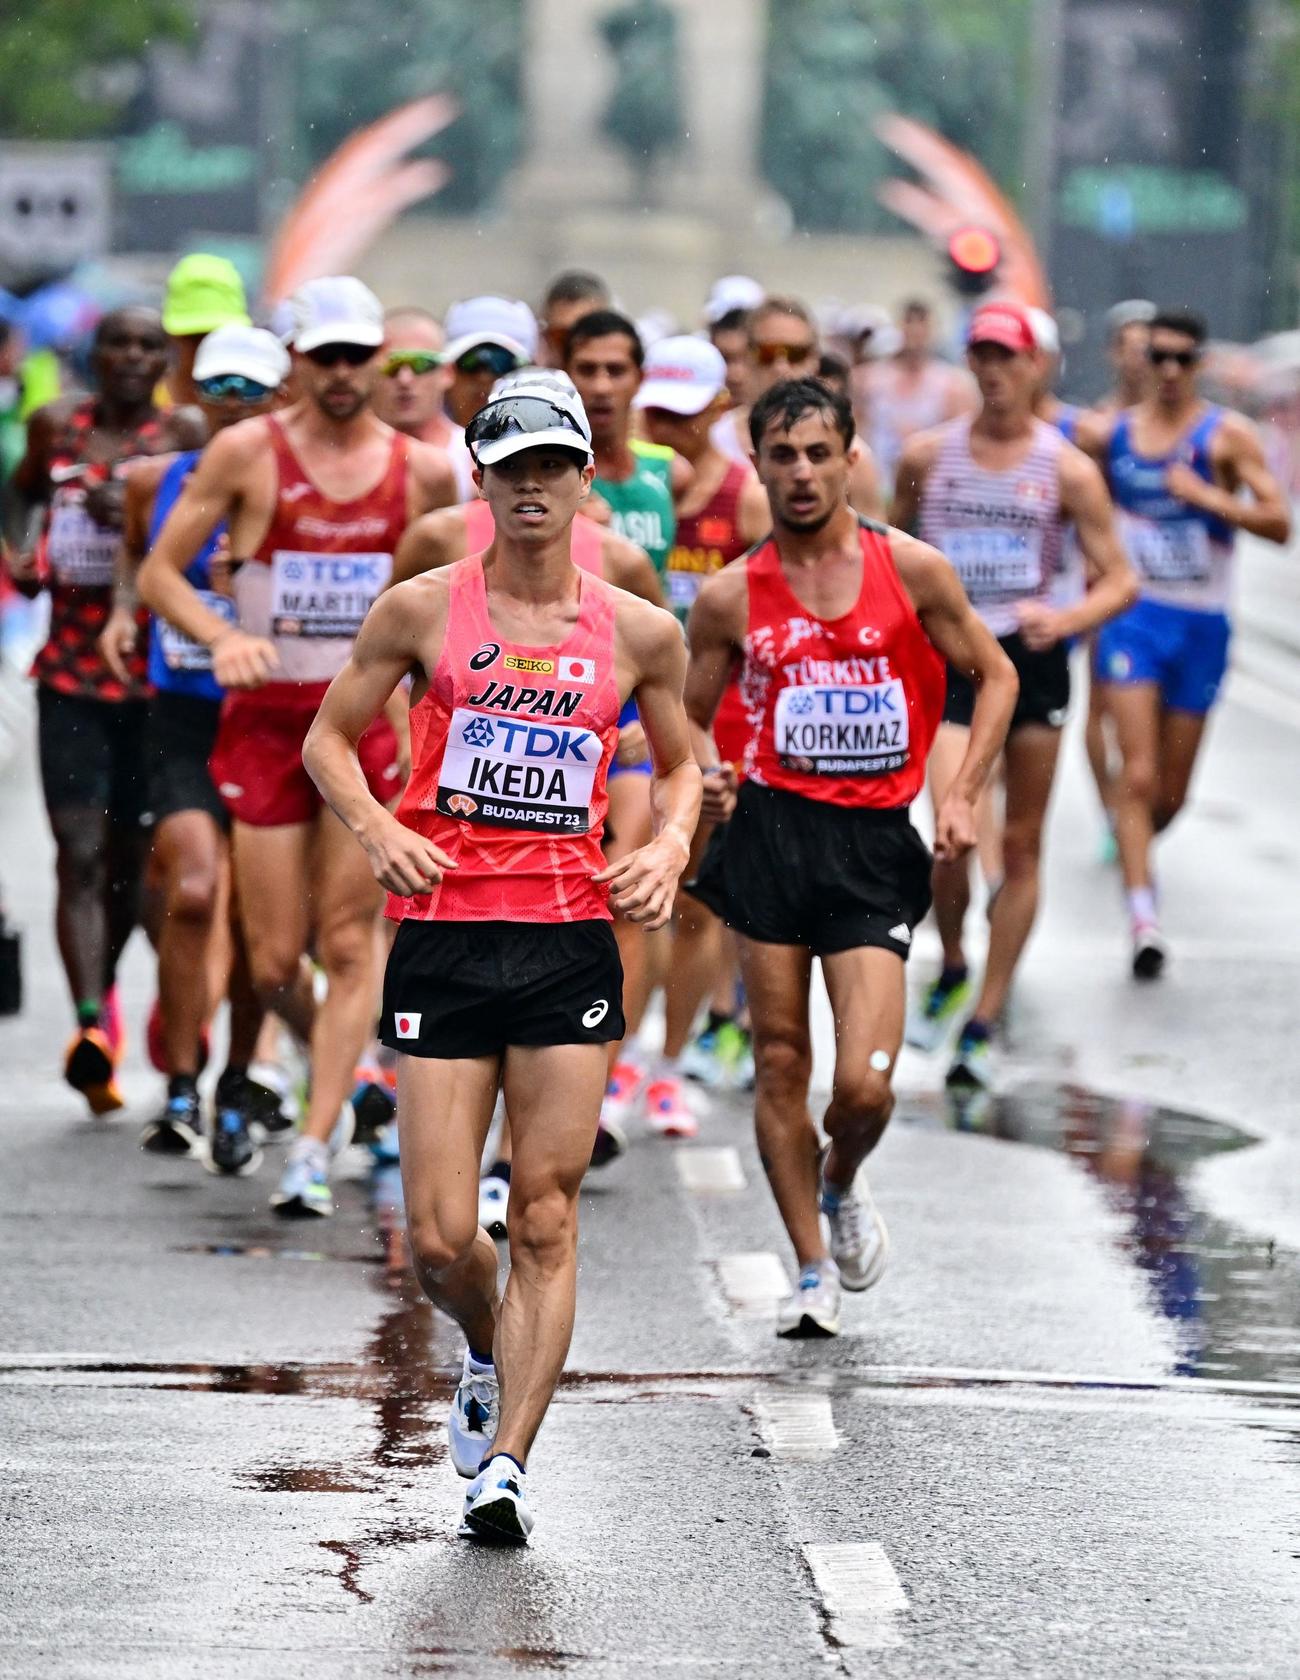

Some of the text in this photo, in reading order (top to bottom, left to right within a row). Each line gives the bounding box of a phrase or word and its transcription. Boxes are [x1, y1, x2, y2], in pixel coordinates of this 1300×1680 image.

[309, 559, 380, 582] TDK
[505, 656, 553, 673] SEIKO
[783, 655, 892, 686] TÜRKİYE
[468, 682, 583, 718] JAPAN
[815, 687, 896, 714] TDK
[497, 720, 593, 762] TDK
[785, 721, 902, 751] KORKMAZ
[467, 757, 567, 802] IKEDA
[816, 758, 887, 773] BUDAPEST
[482, 804, 581, 826] BUDAPEST 23
